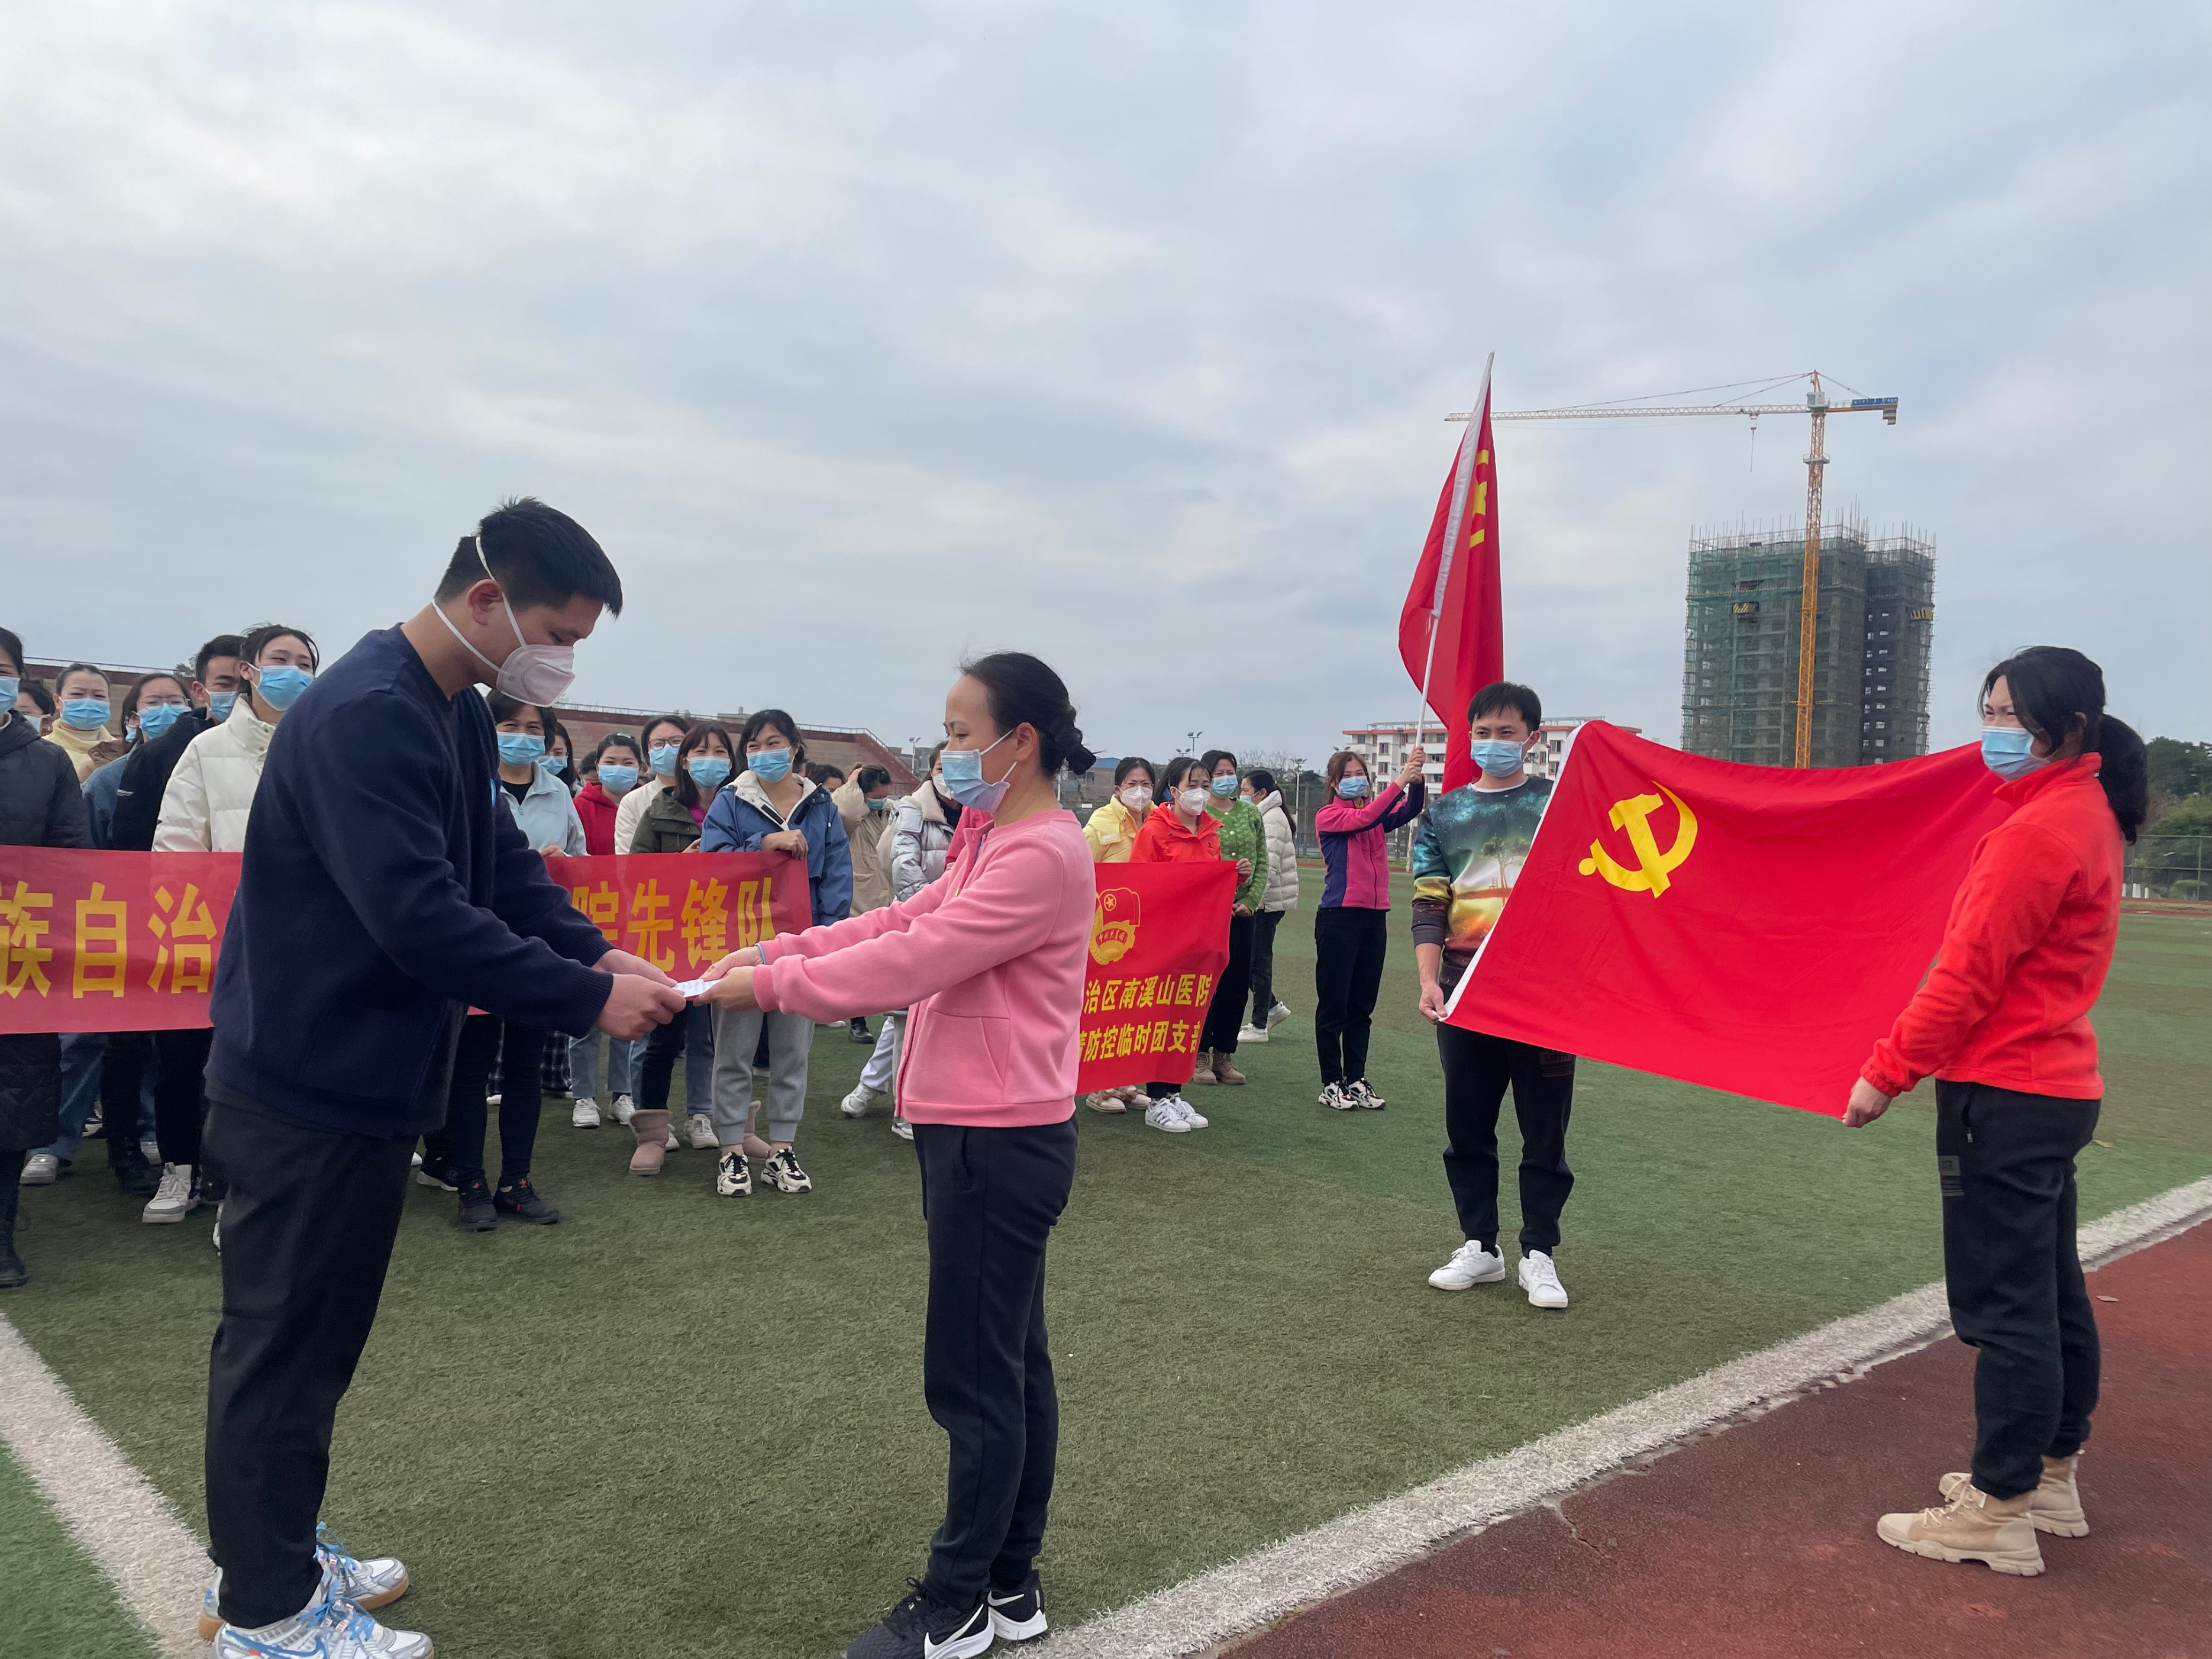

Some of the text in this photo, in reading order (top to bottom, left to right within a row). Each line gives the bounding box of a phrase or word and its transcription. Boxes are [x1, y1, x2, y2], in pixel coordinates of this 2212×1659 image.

[0, 880, 217, 999] 族自治
[571, 877, 776, 972] 院先锋队
[1083, 973, 1213, 1014] 治区南溪山医院
